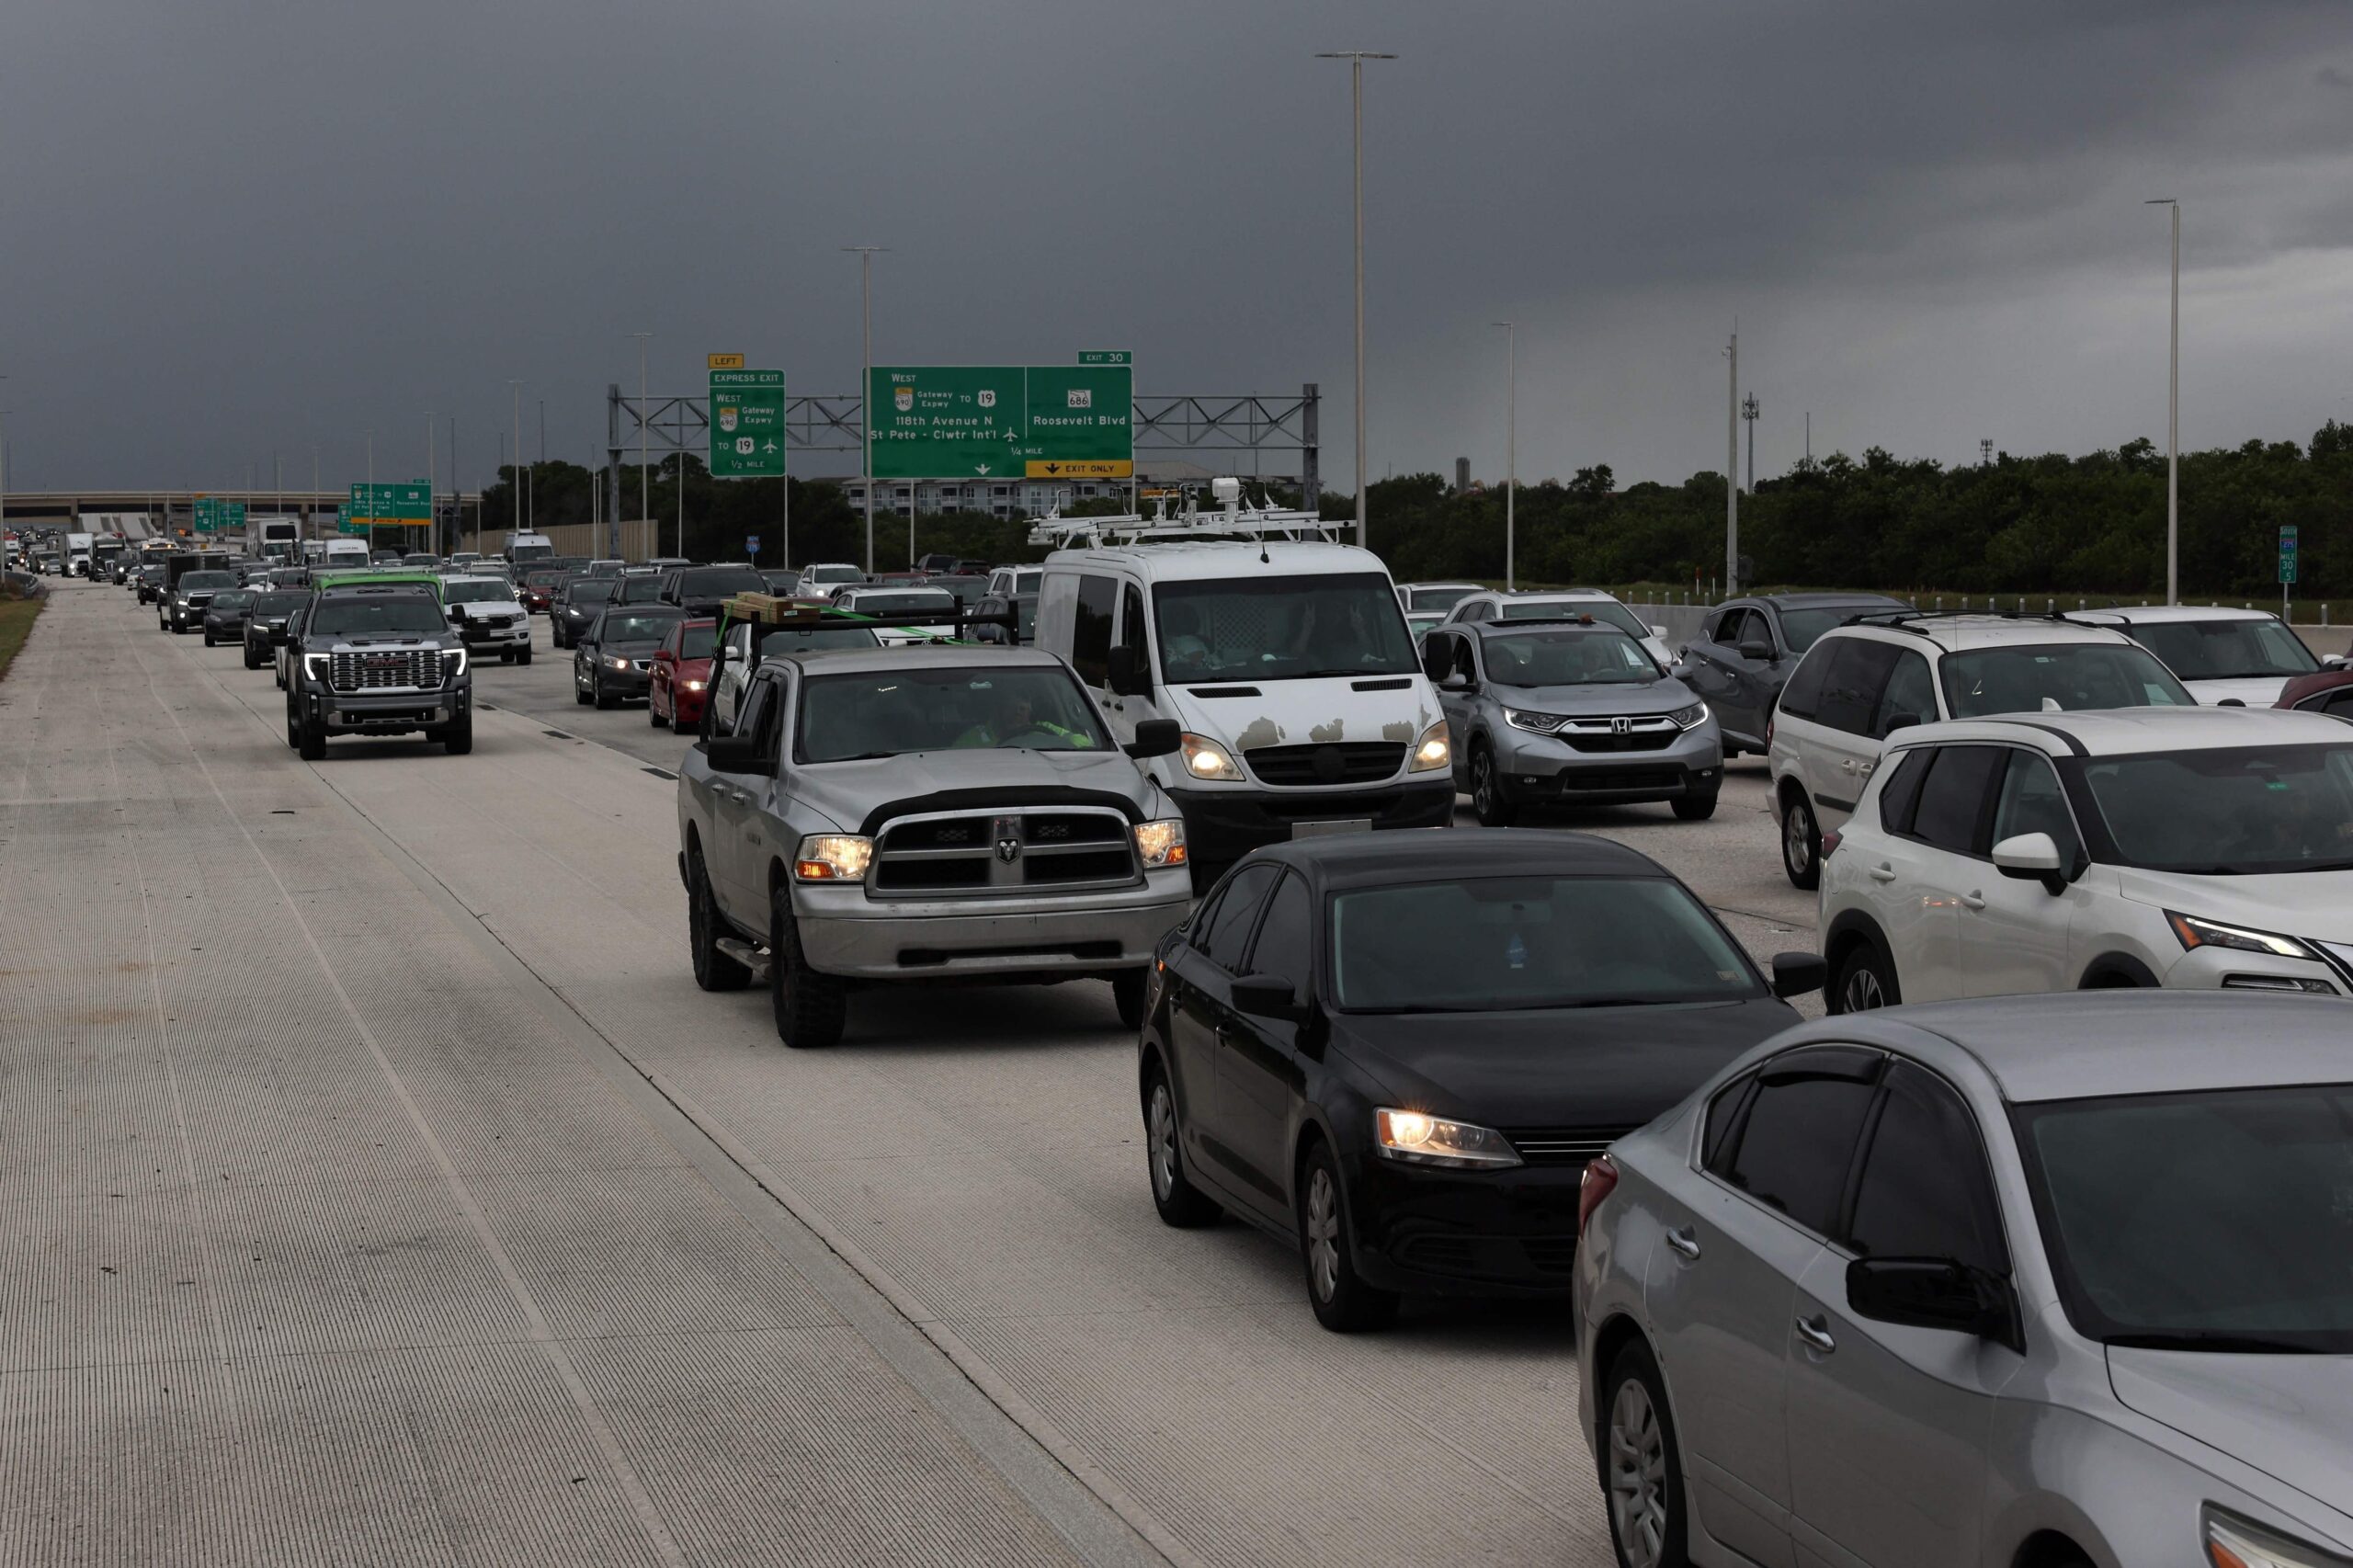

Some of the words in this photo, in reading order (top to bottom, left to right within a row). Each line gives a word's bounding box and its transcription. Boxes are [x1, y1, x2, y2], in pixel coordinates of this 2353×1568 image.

[1108, 353, 1123, 362] 30
[714, 374, 756, 382] EXPRESS
[759, 374, 779, 382] EXIT
[892, 373, 916, 382] WEST
[716, 393, 742, 403] WEST
[917, 391, 952, 399] Gateway
[982, 393, 993, 403] 19
[1069, 396, 1088, 405] 686
[922, 400, 949, 408] Expwy
[742, 406, 775, 415] Gateway
[745, 416, 772, 425] Expwy
[896, 416, 926, 426] 118th
[933, 416, 978, 426] Avenue
[984, 416, 993, 426] N
[1033, 415, 1093, 426] Roosevelt
[1099, 415, 1125, 426] Blvd
[870, 430, 882, 439] St
[890, 430, 916, 439] Pete
[933, 430, 966, 439] Clwtr
[972, 430, 996, 439] Int'l
[740, 440, 751, 450] 19
[1011, 447, 1021, 456] 1/4
[732, 460, 742, 469] 1/2
[2280, 552, 2295, 561] MILE
[2282, 561, 2293, 570] 30
[367, 658, 408, 666] GMC
